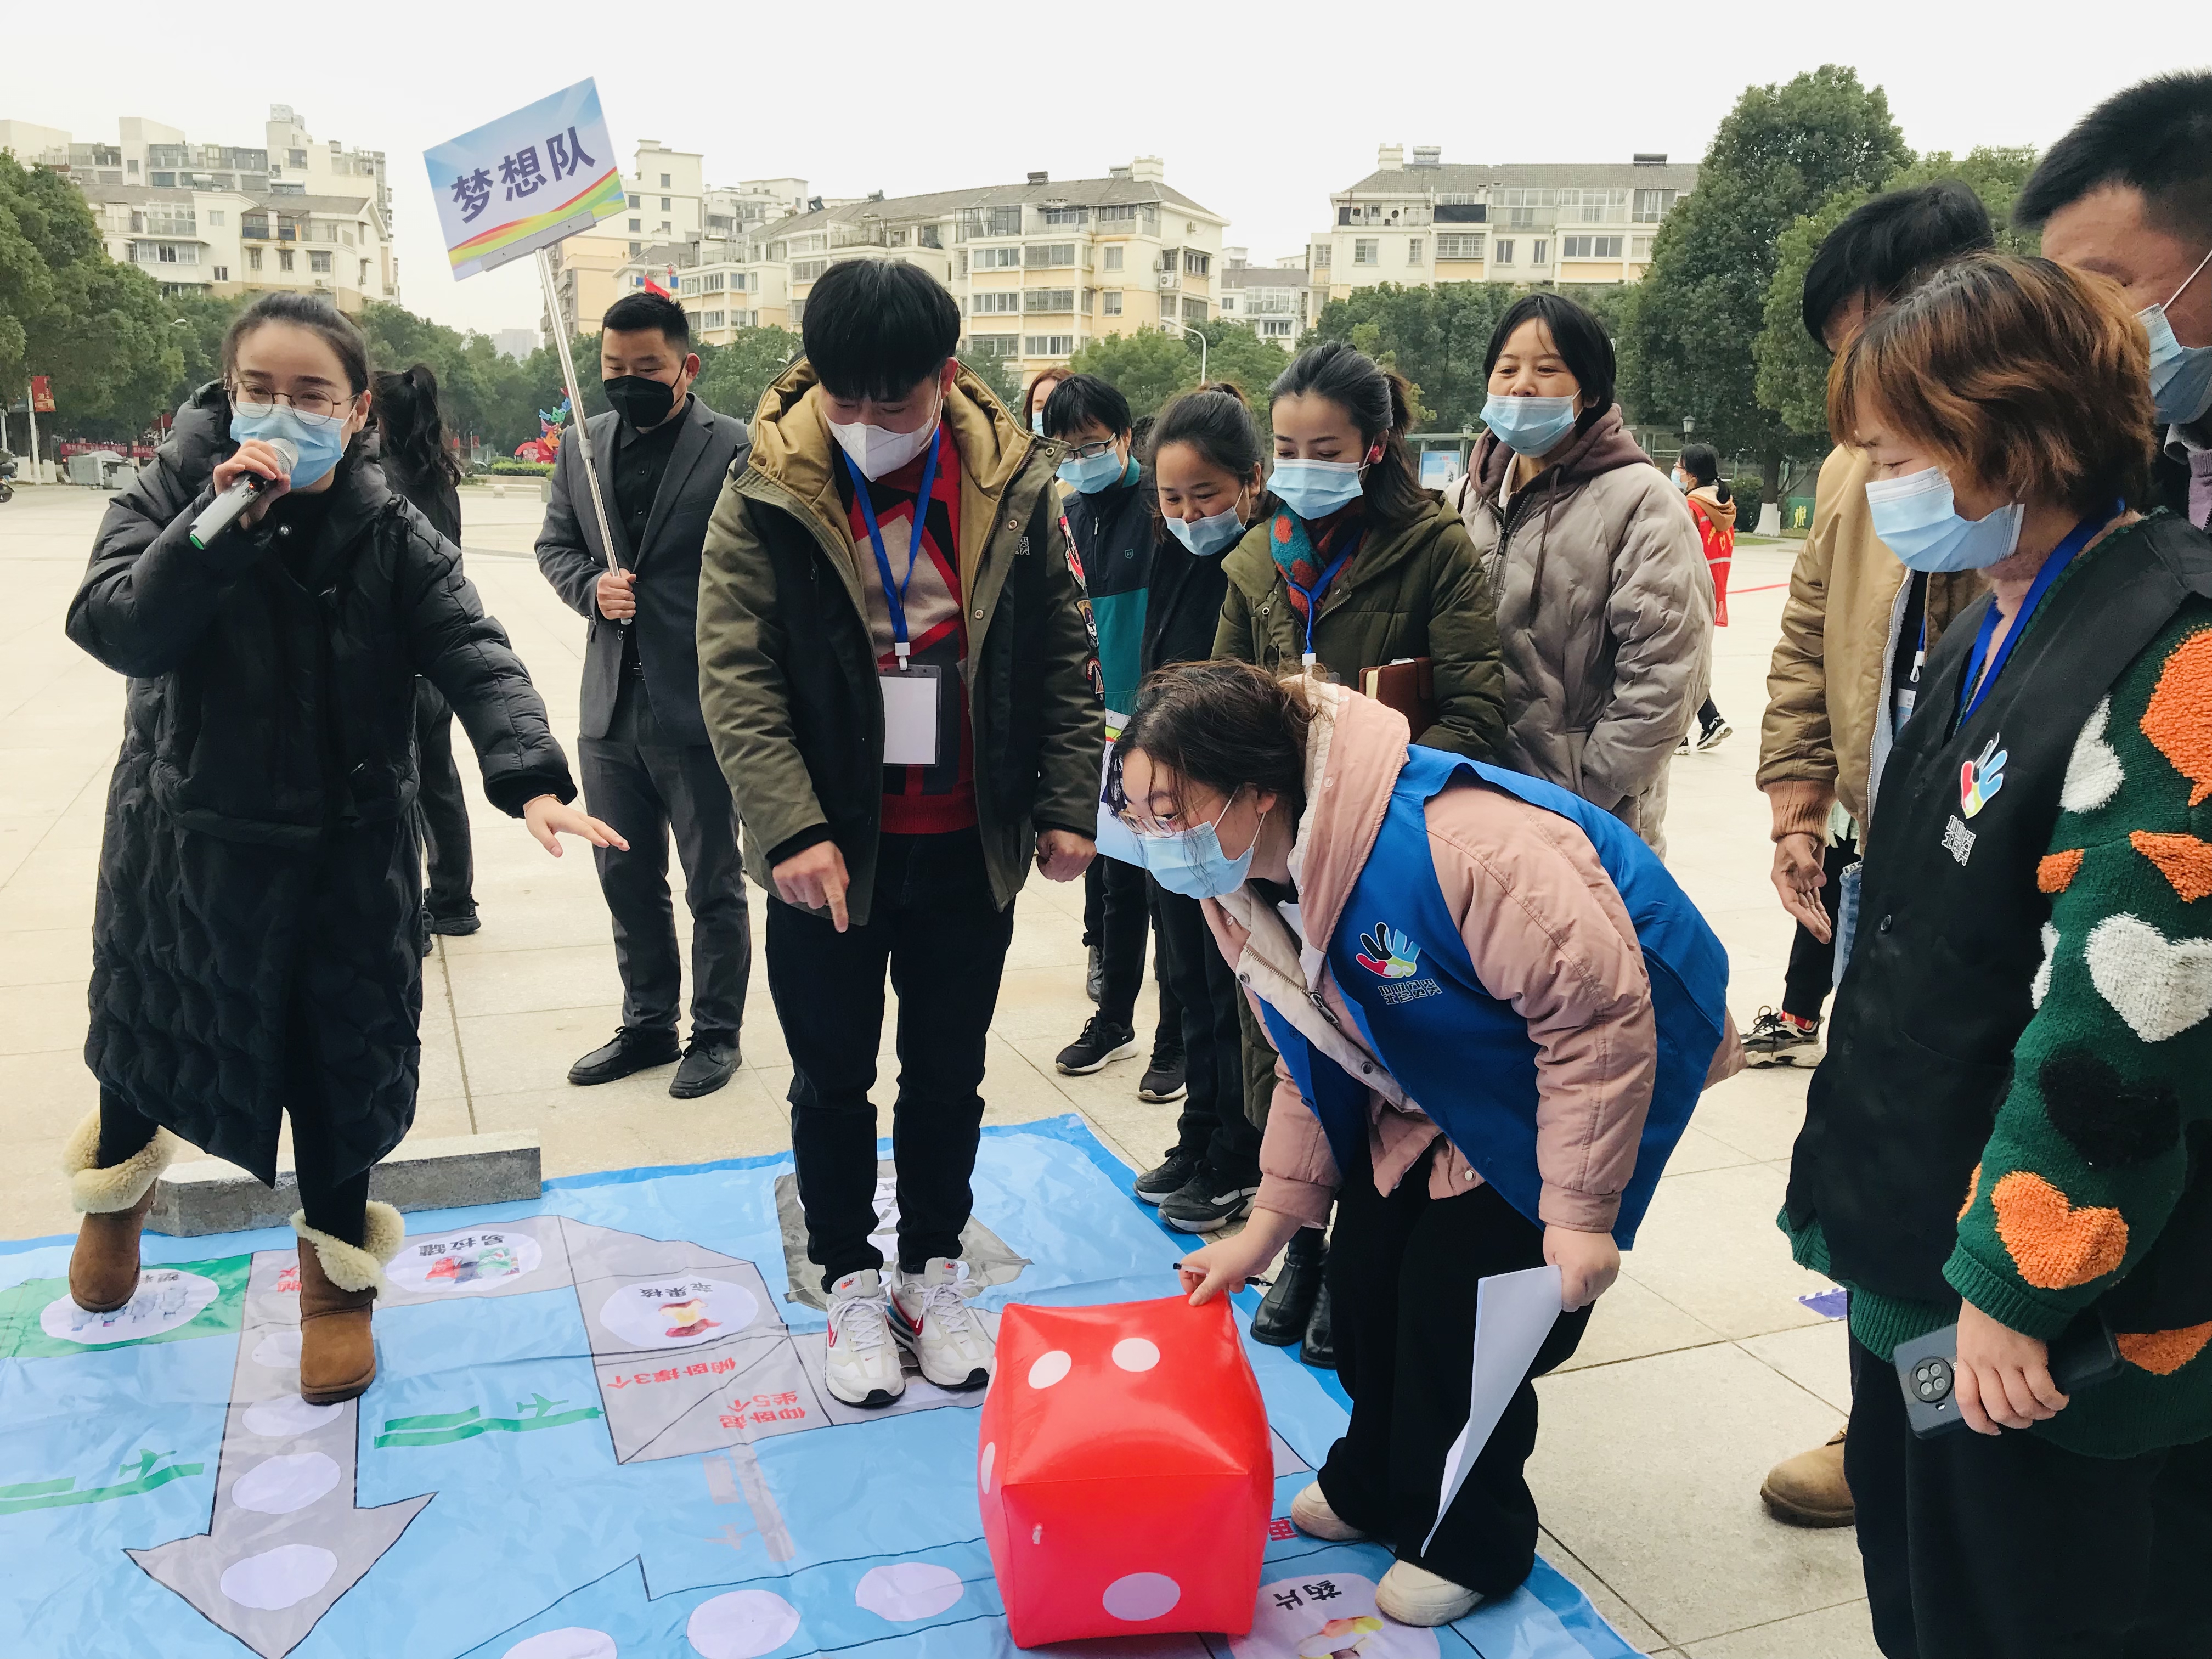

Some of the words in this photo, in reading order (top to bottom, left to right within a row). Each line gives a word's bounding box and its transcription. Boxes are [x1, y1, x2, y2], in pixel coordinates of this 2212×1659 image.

[451, 126, 596, 224] 梦想队
[419, 1234, 505, 1257] 易拉罐
[639, 1283, 713, 1299] 苹果核
[607, 1357, 736, 1389] 俯卧撑3个
[727, 1391, 798, 1413] 坐5个
[719, 1407, 806, 1430] 仰卧起
[1273, 1580, 1342, 1611] 药片
